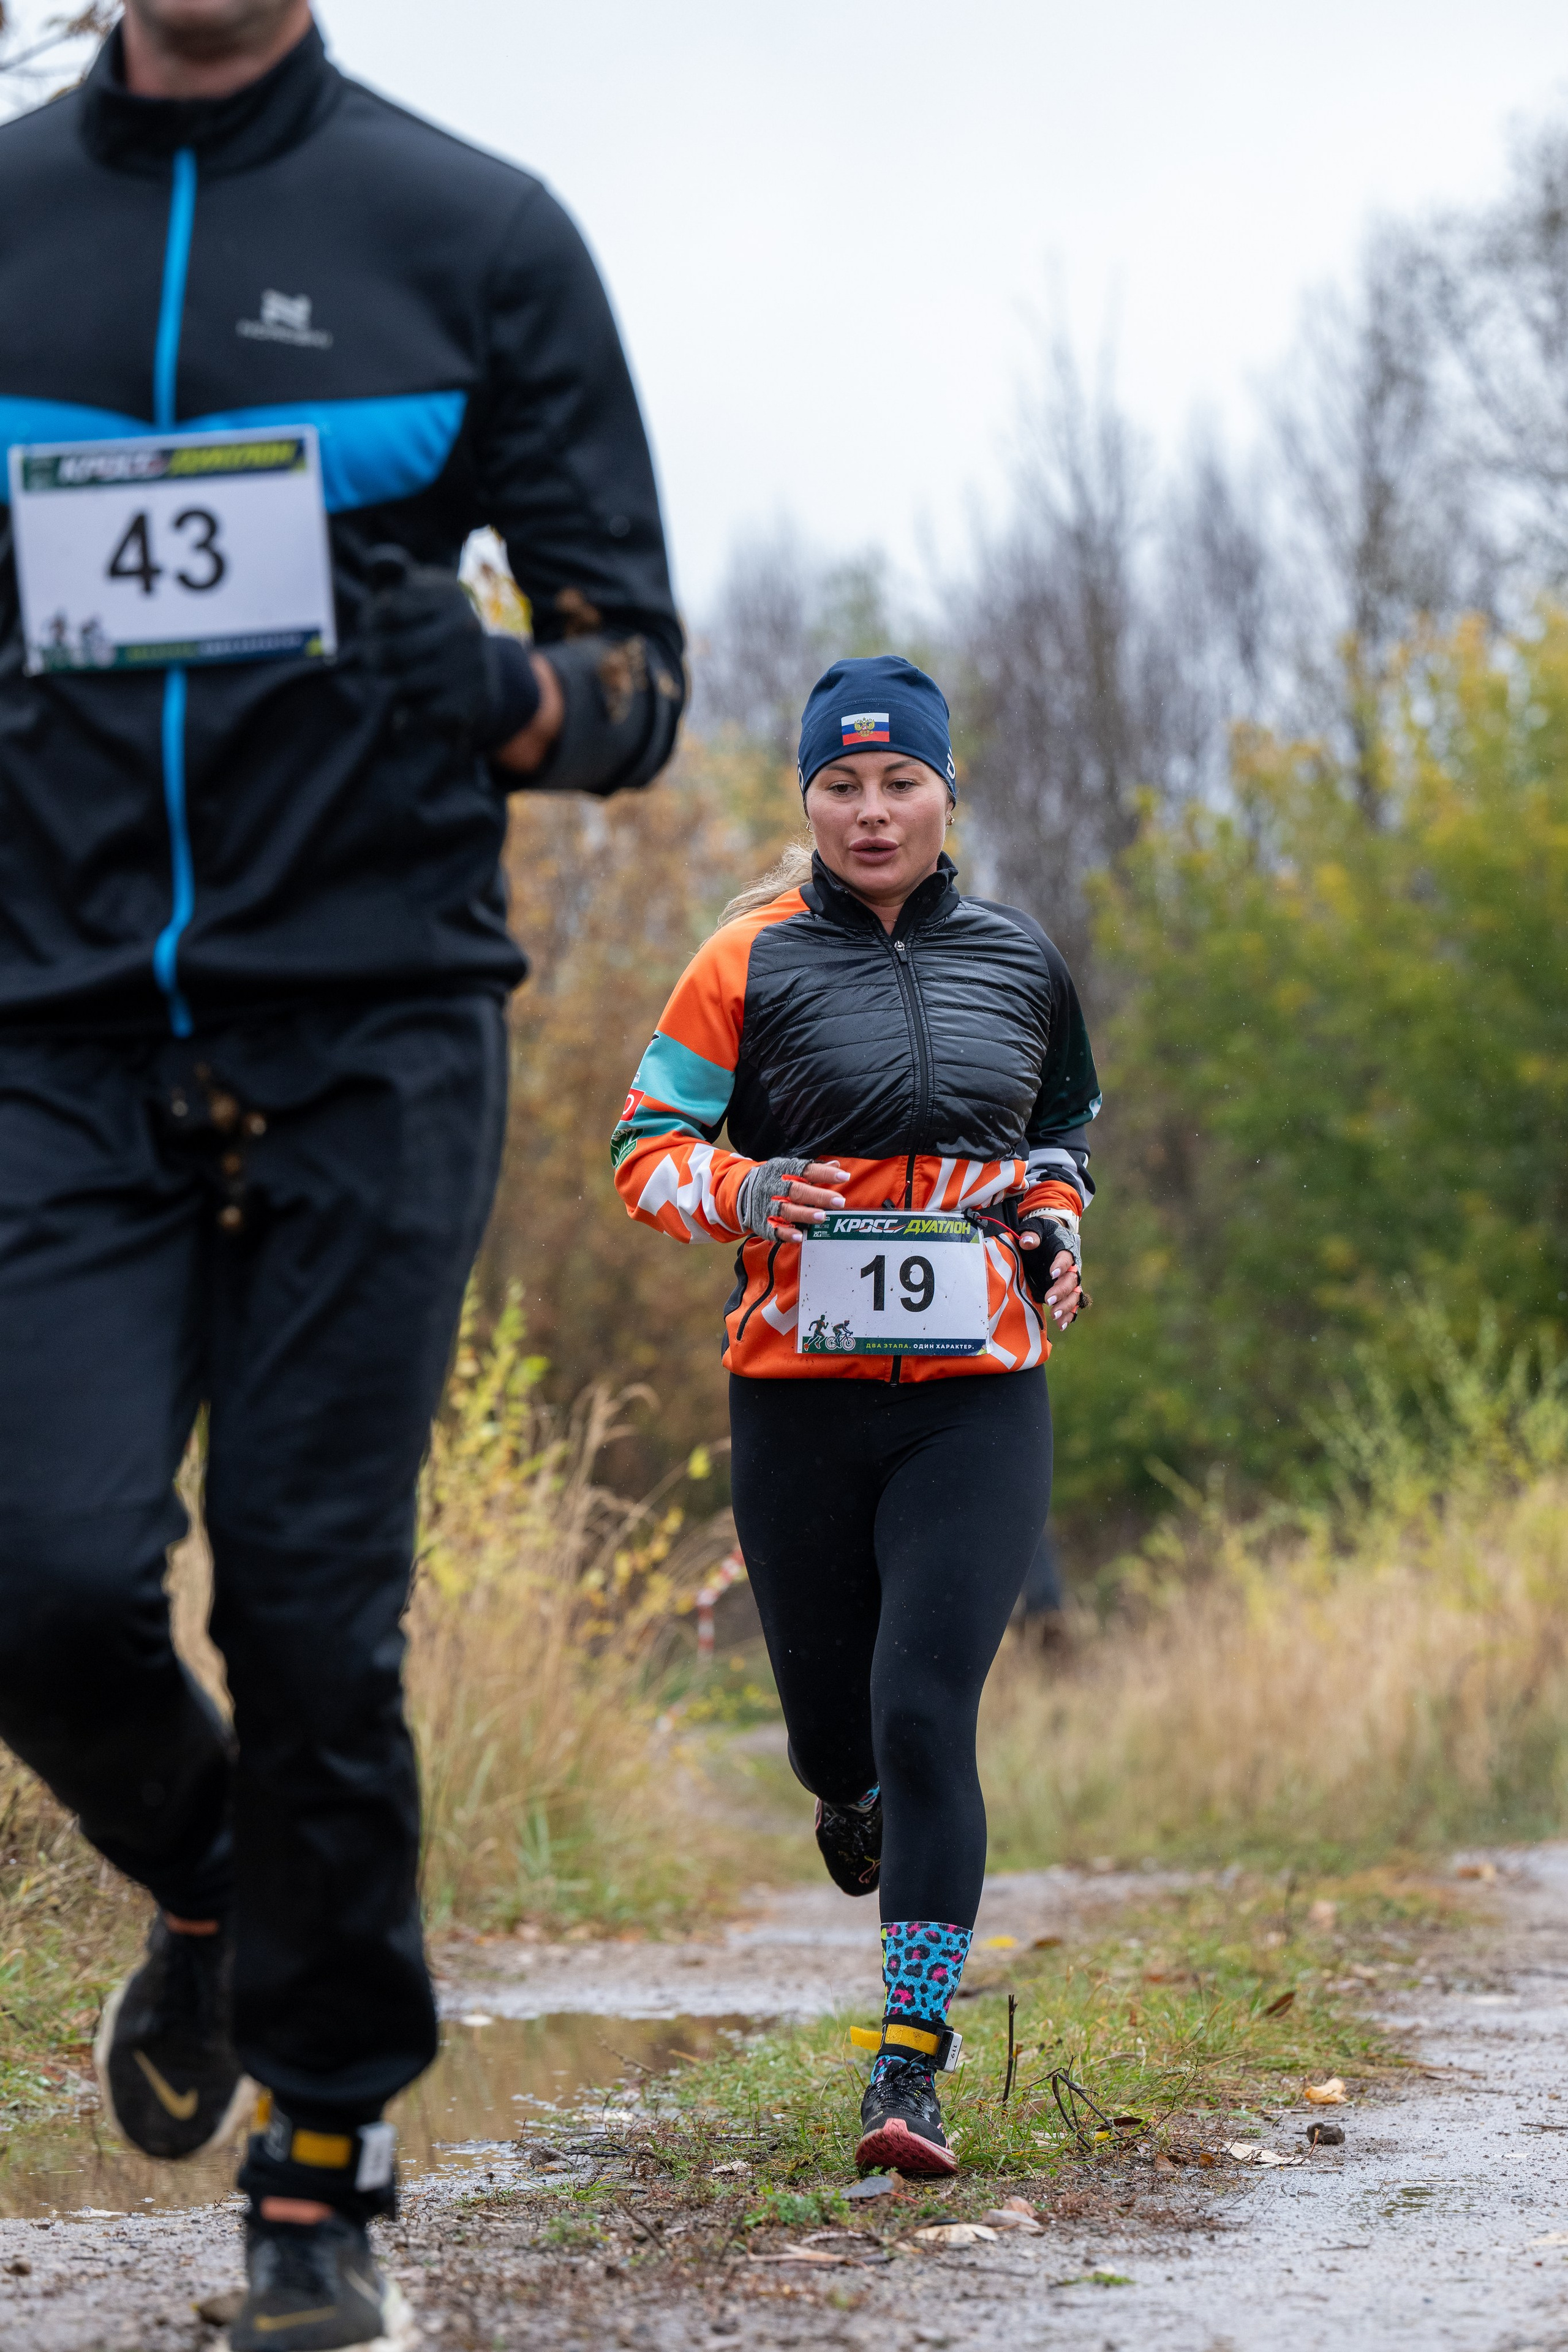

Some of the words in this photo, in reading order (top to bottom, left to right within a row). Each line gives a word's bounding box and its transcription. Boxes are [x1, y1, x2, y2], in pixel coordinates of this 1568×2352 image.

[107, 508, 227, 595] 43
[833, 1218, 906, 1234] КРОСС
[903, 1219, 971, 1235] ДУАТЛОН
[860, 1254, 935, 1313] 19
